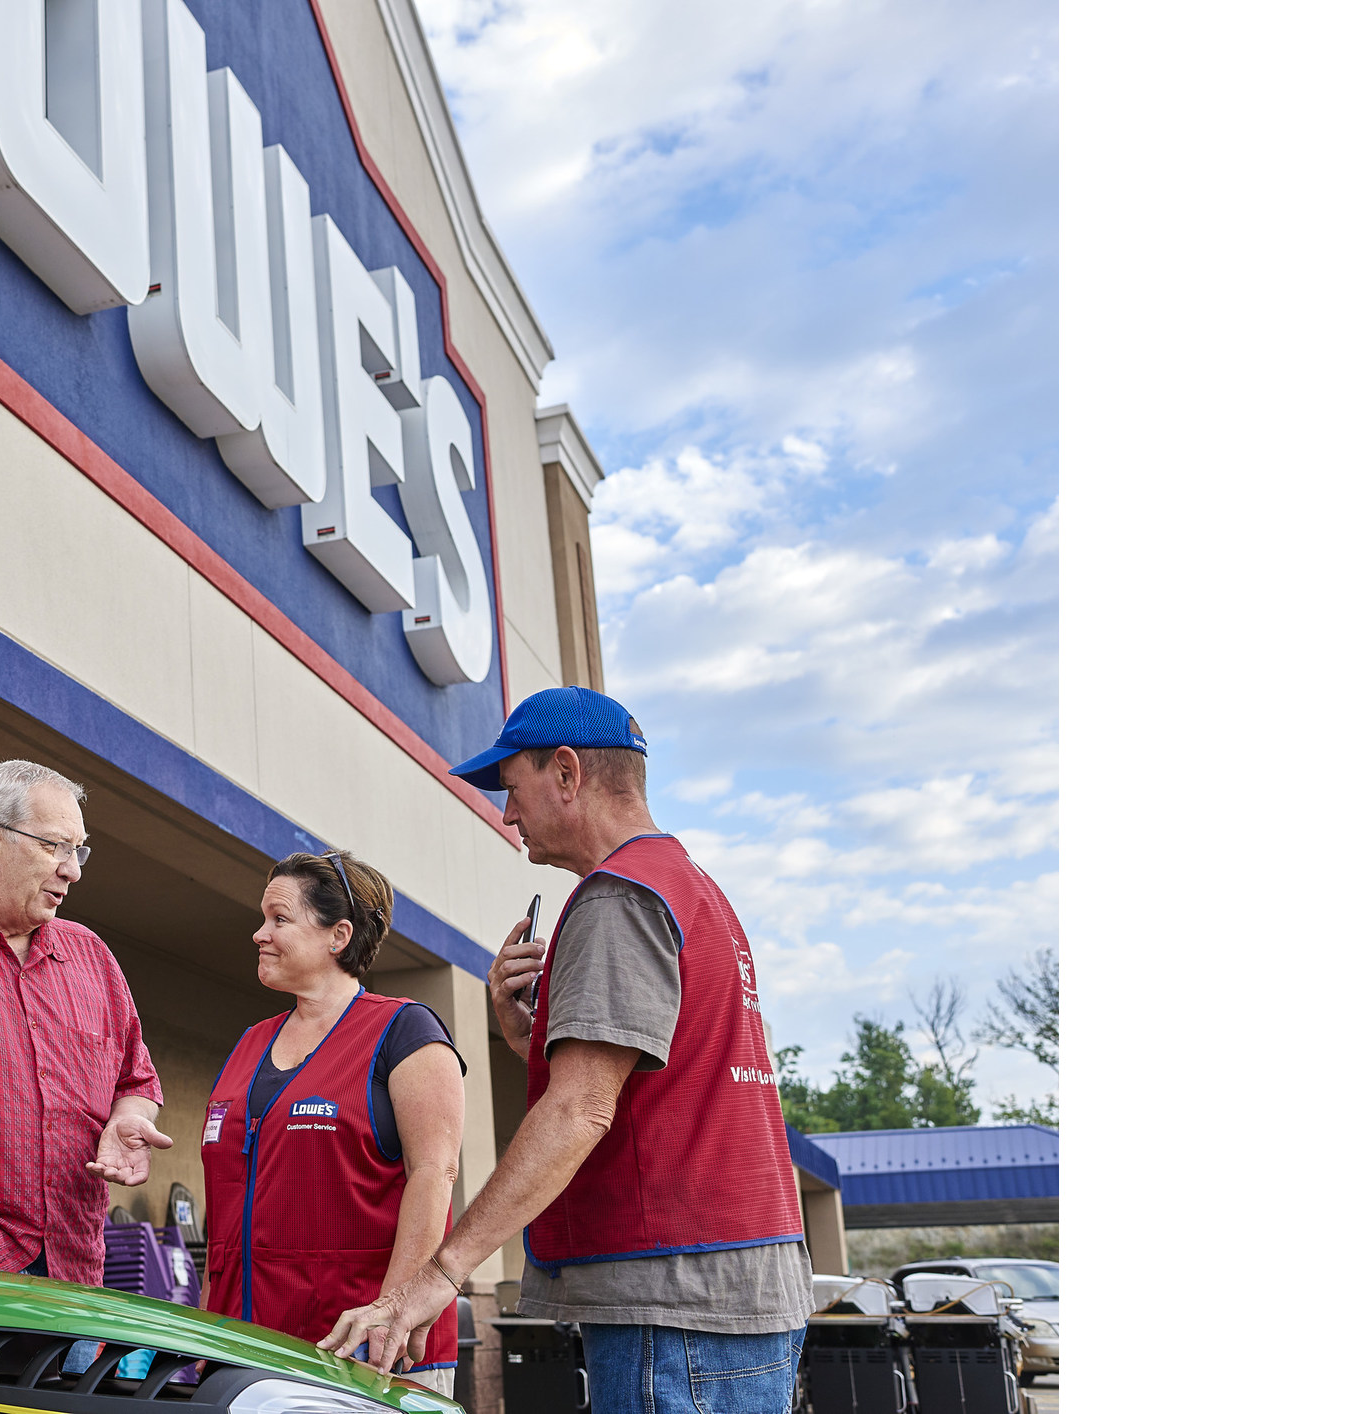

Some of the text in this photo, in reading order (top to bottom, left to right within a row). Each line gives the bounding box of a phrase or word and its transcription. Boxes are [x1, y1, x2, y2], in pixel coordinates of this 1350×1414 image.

[730, 1066, 757, 1083] Visit
[292, 1103, 335, 1116] LOWE'S
[287, 1123, 337, 1132] Customer Service
